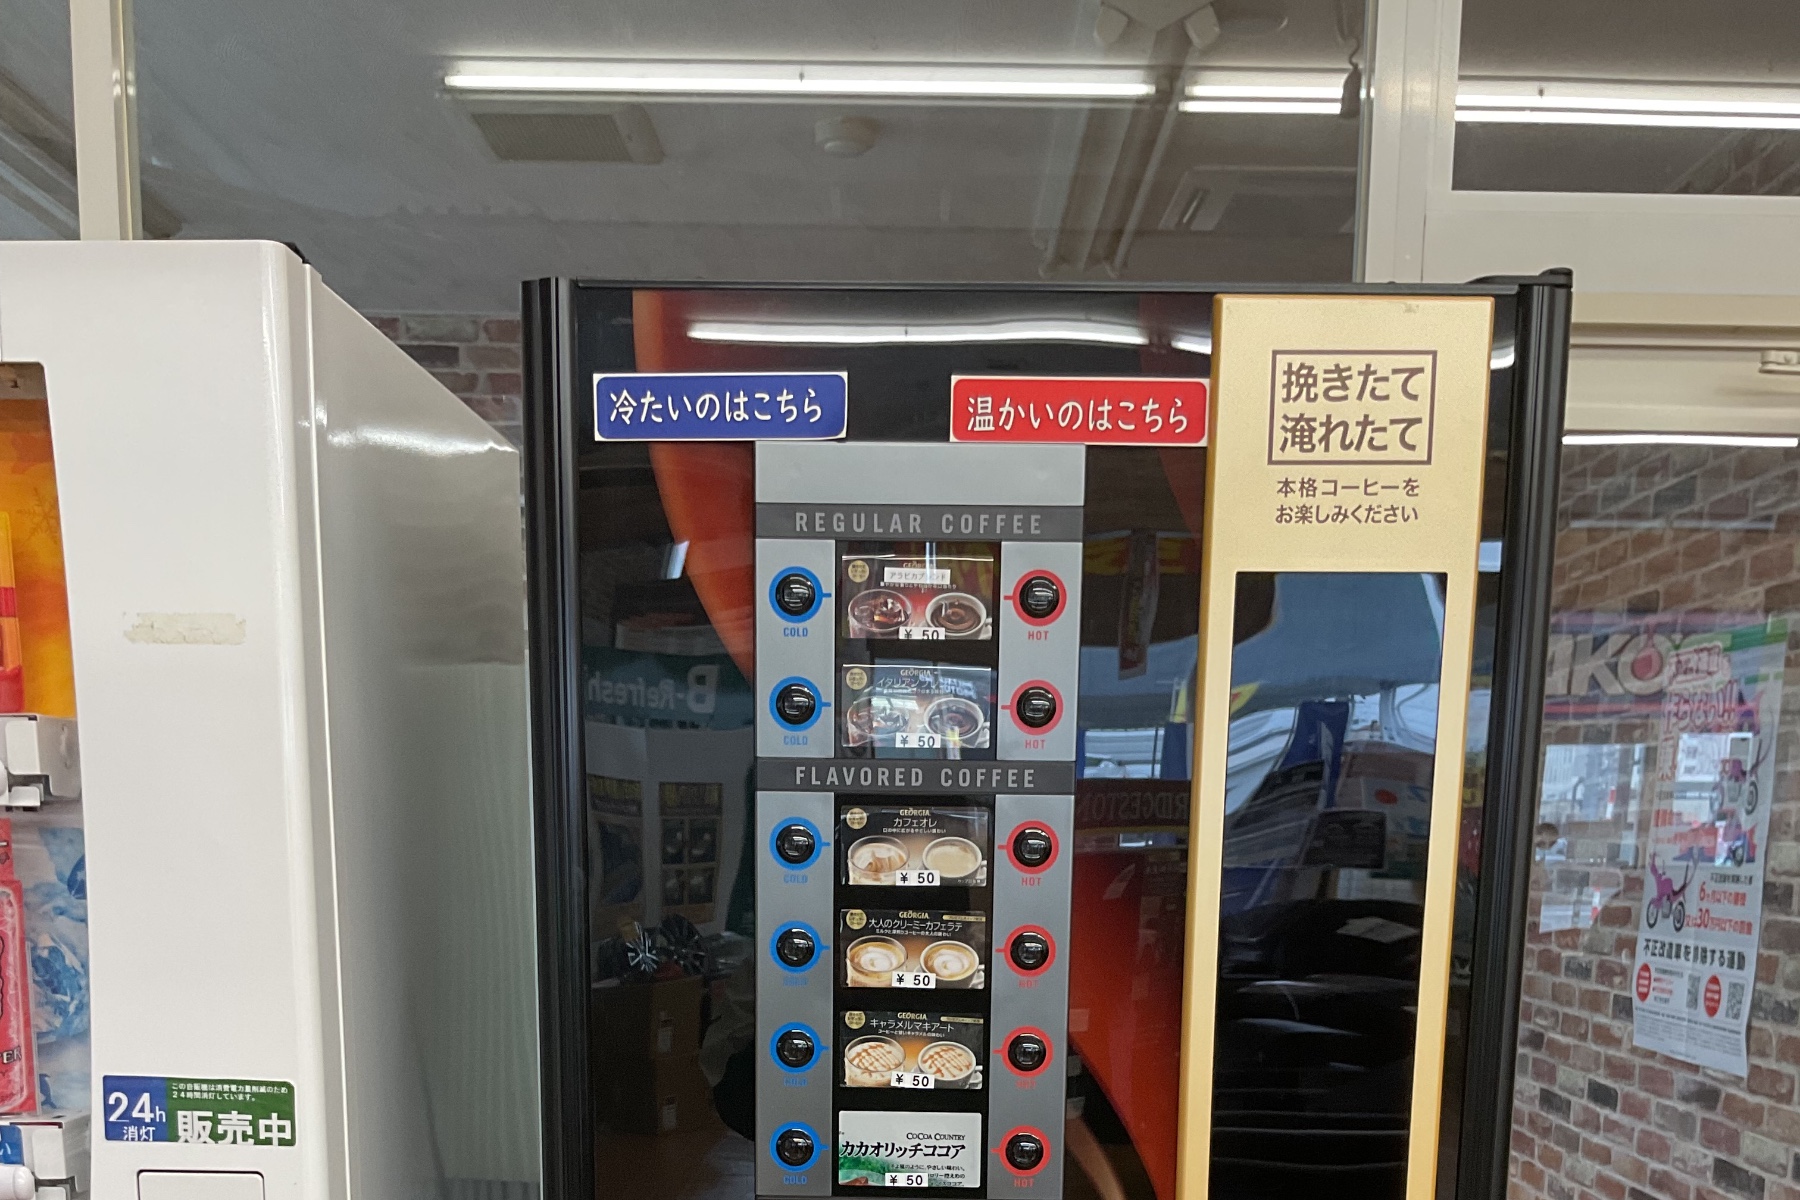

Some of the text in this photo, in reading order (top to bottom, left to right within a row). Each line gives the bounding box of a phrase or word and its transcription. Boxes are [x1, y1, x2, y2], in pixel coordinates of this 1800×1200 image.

[1282, 363, 1425, 403] 挽きたて
[609, 389, 824, 424] 冷たいのはこちら
[967, 397, 1189, 433] 温かいのはこちら
[1279, 413, 1422, 453] 淹れたて
[1277, 477, 1419, 497] 本格コーヒーを
[1275, 505, 1418, 524] お楽しみください
[795, 513, 1043, 534] REGULAR COFFEE
[783, 627, 808, 638] COLD
[922, 630, 940, 640] 50
[1027, 630, 1049, 640] HOT
[783, 736, 808, 746] COLD
[918, 736, 935, 748] 50
[1025, 739, 1046, 749] HOT
[796, 766, 1035, 788] FLAVORED COFFEE
[900, 808, 931, 816] GEORGIA
[893, 817, 937, 828] カフェオレ
[917, 872, 934, 884] 50
[1021, 877, 1042, 887] HOT
[899, 910, 930, 919] GEORGIA
[869, 918, 963, 932] 大人のクリーミーカフェラテ
[913, 975, 930, 986] 50
[897, 1012, 927, 1020] GEORGIA
[870, 1018, 954, 1033] キャラメルマキアート
[912, 1075, 929, 1087] 50
[108, 1091, 166, 1123] 24h
[123, 1125, 156, 1142] 消灯
[177, 1110, 292, 1146] 販売中
[840, 1141, 966, 1159] カカオリッチココア
[906, 1175, 923, 1186] 50
